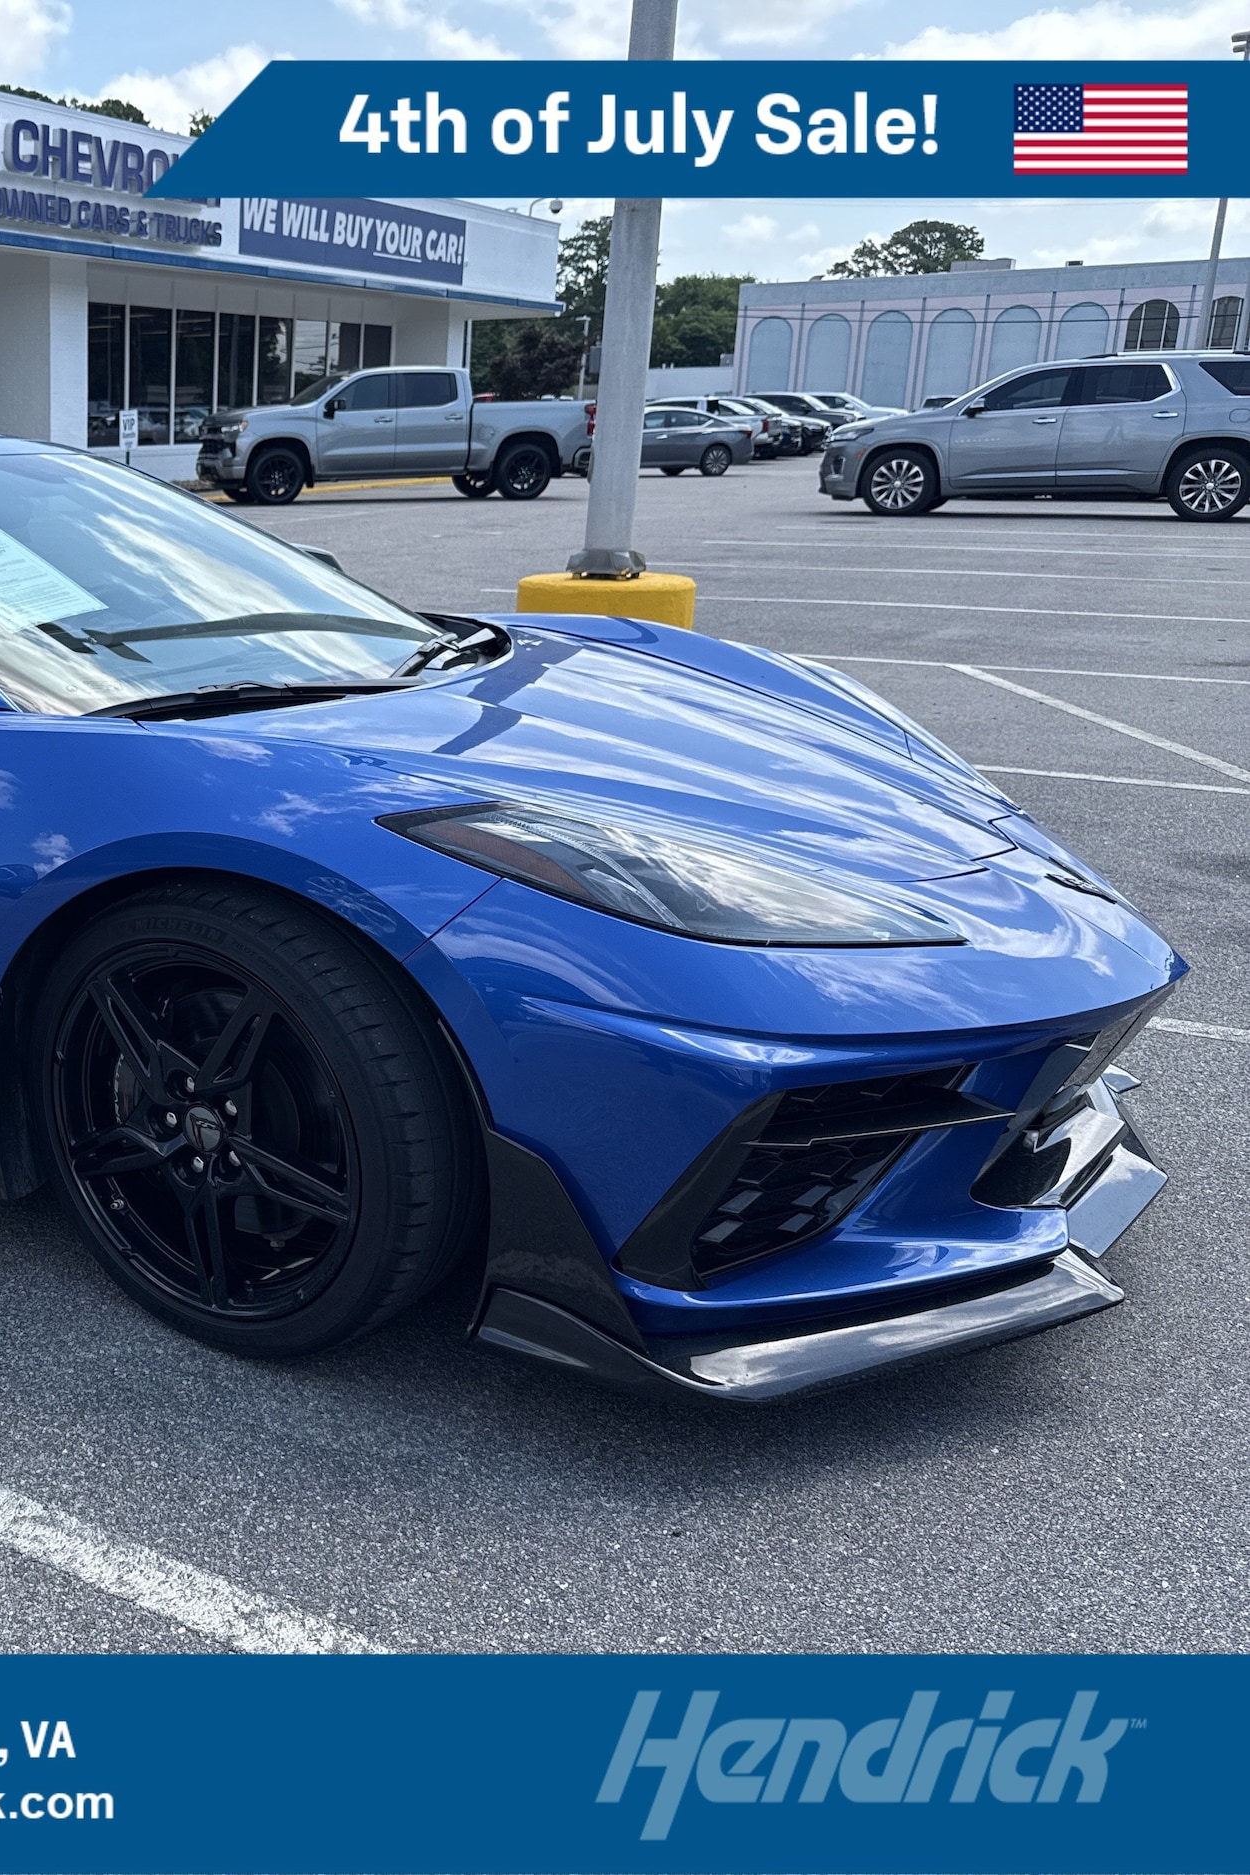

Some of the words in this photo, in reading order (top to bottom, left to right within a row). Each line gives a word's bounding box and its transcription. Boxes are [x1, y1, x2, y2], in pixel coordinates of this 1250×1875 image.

[6, 119, 221, 208] CHEVRO
[74, 200, 130, 235] CARS
[135, 210, 149, 238] &
[150, 211, 222, 247] TRUCKS
[243, 197, 279, 234] WE
[282, 201, 330, 244] WILL
[333, 211, 375, 249] BUY
[374, 219, 423, 258] YOUR
[425, 229, 465, 266] CAR!
[135, 918, 221, 941] MICHELIN
